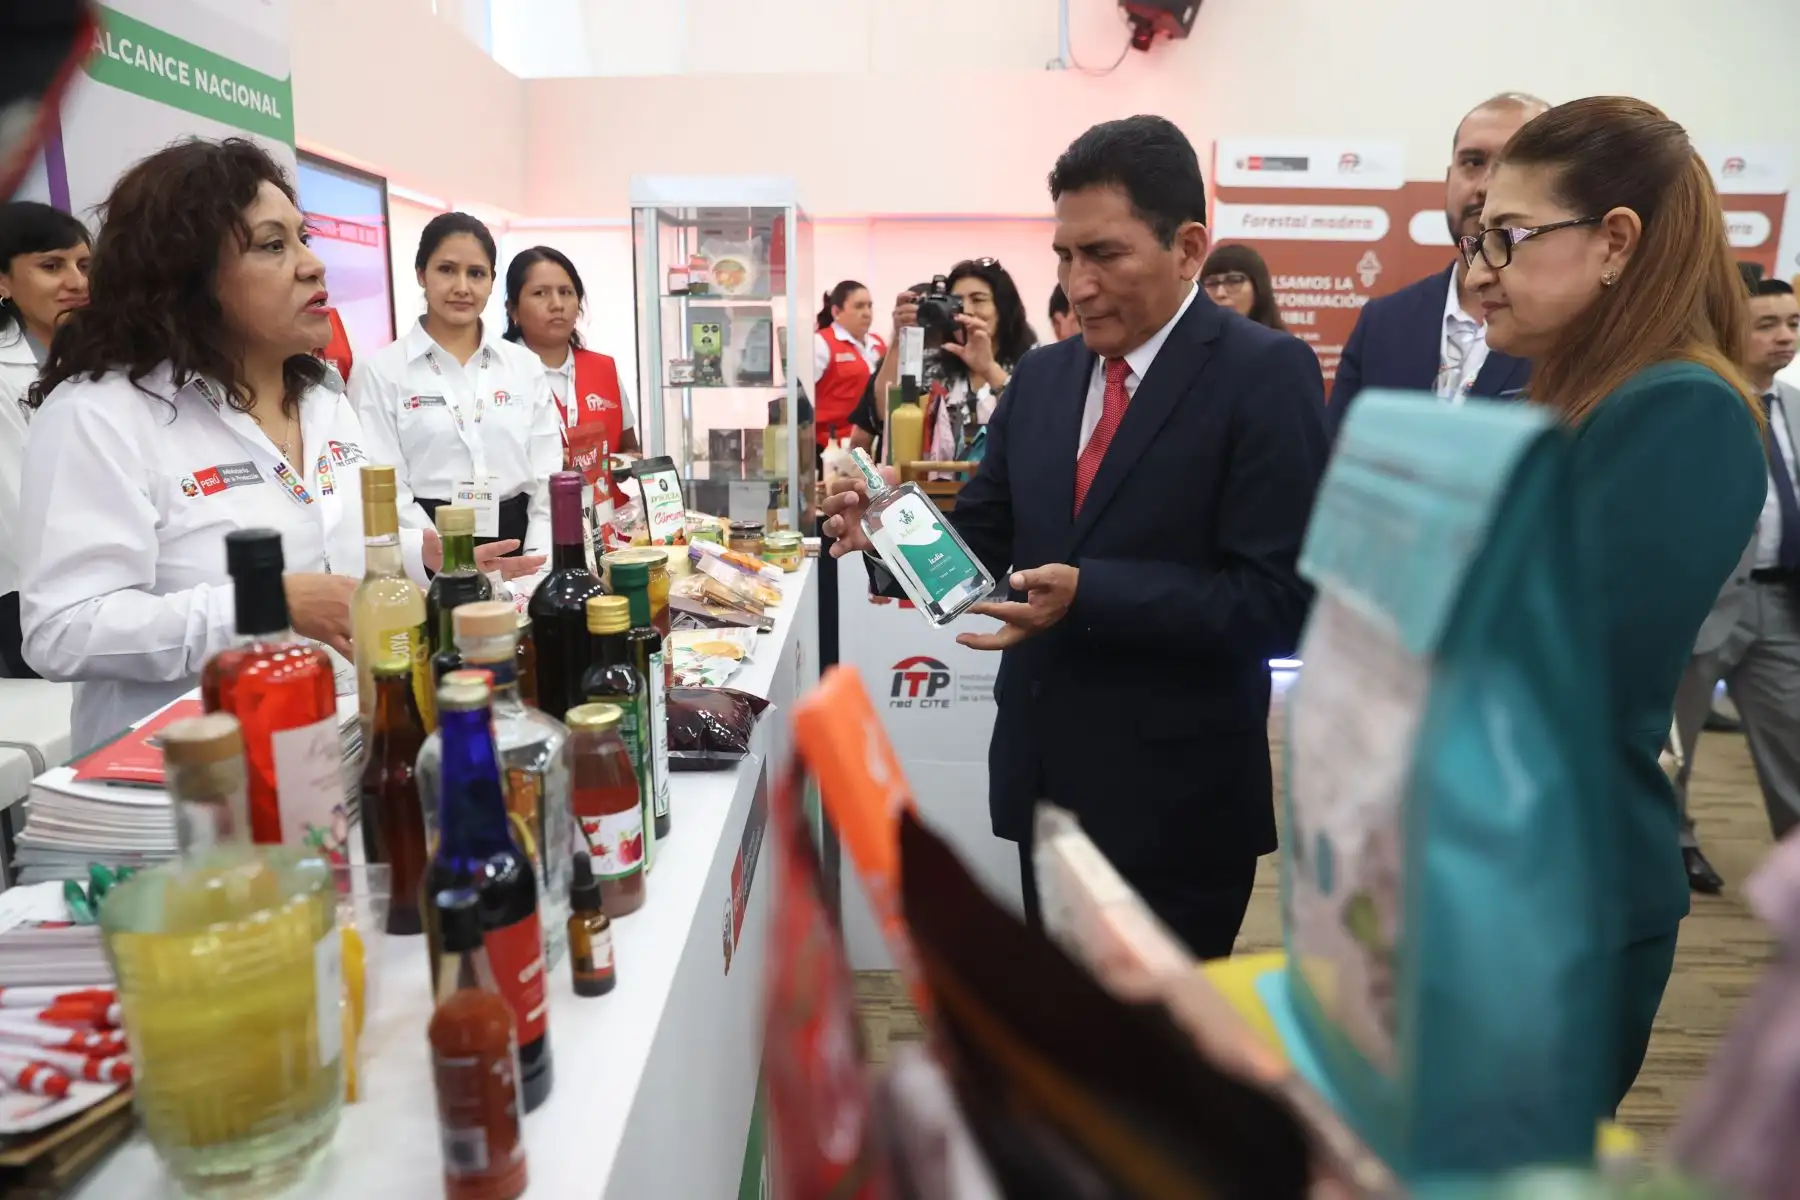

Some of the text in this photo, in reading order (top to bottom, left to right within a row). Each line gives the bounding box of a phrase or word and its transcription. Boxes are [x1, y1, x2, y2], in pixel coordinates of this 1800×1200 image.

[92, 27, 282, 119] ALCANCE NACIONAL
[1311, 214, 1374, 230] madera
[1271, 275, 1353, 290] LSAMOS LA
[200, 473, 221, 489] PERÚ
[890, 671, 951, 698] ITP
[889, 699, 950, 708] red CITE
